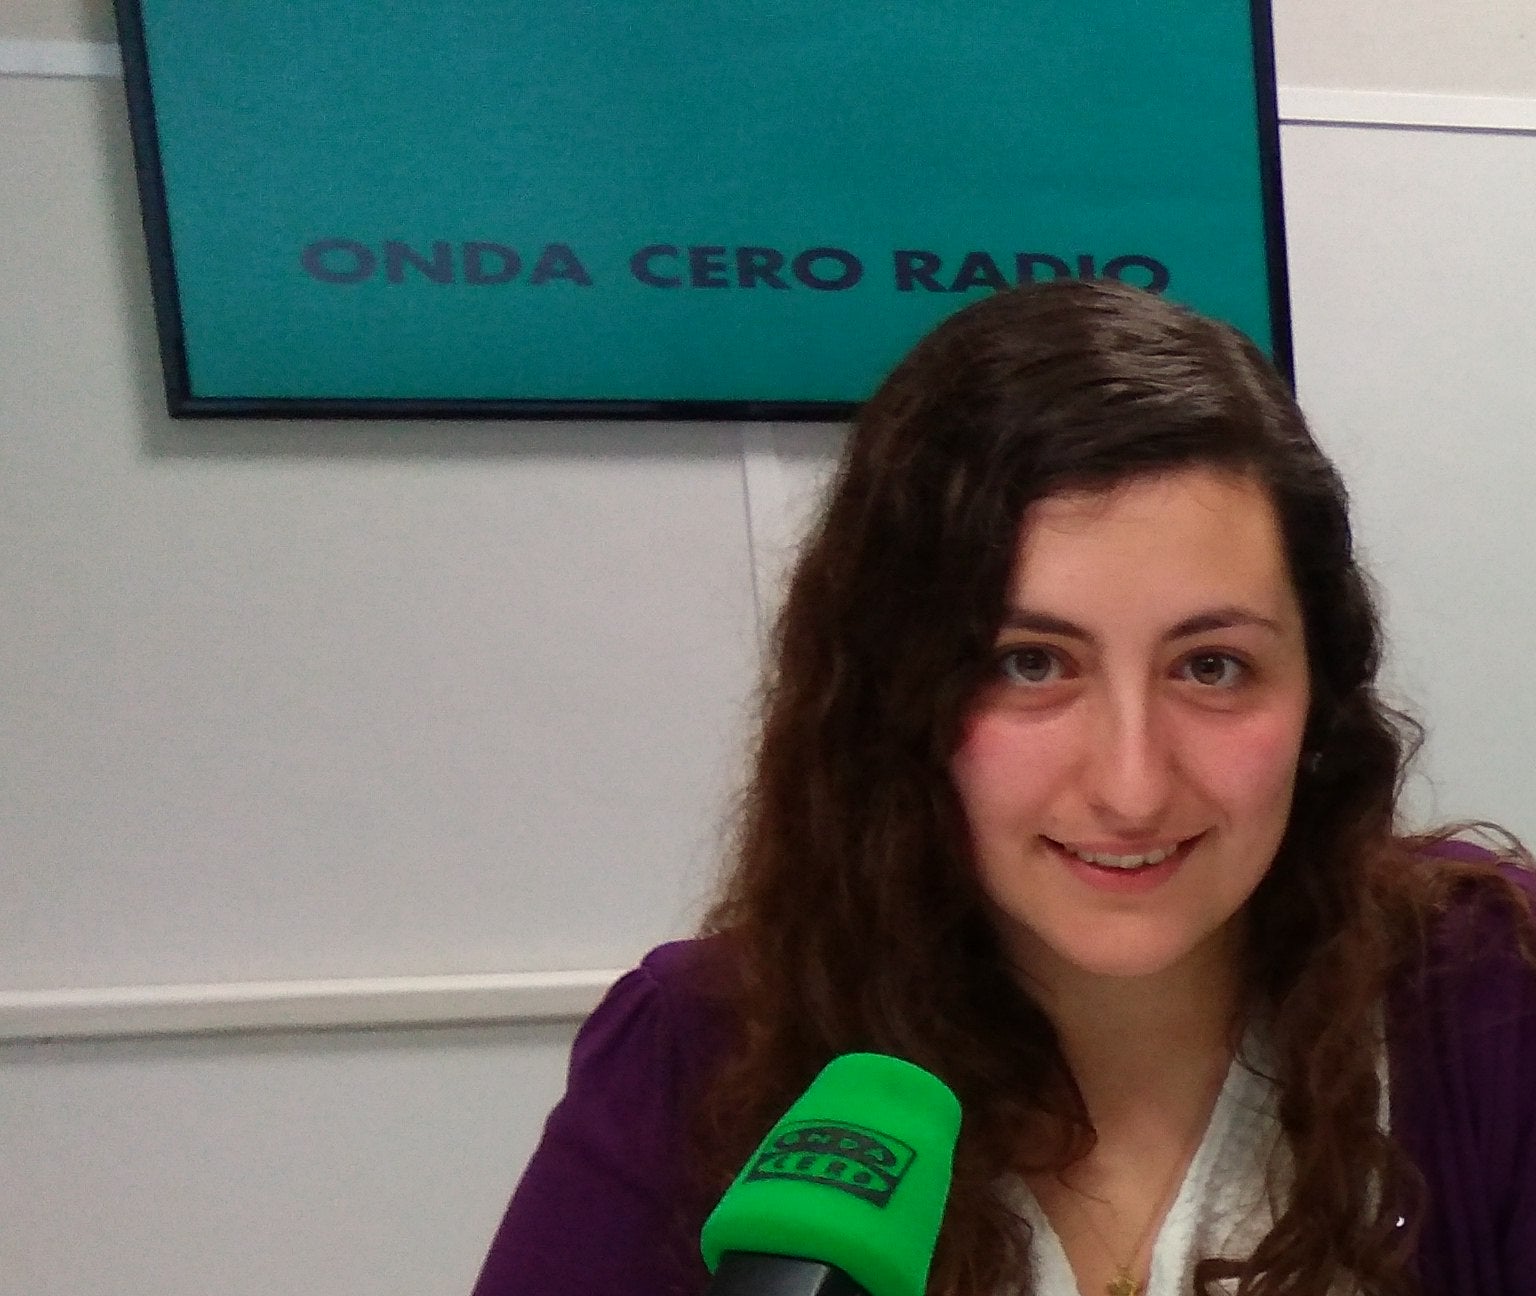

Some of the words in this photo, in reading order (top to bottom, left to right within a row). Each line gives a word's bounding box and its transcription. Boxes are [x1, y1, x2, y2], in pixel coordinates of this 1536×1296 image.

[301, 238, 593, 286] ONDA
[630, 244, 864, 292] CERO
[892, 249, 1171, 294] RADIO
[782, 1132, 885, 1161] ONDA
